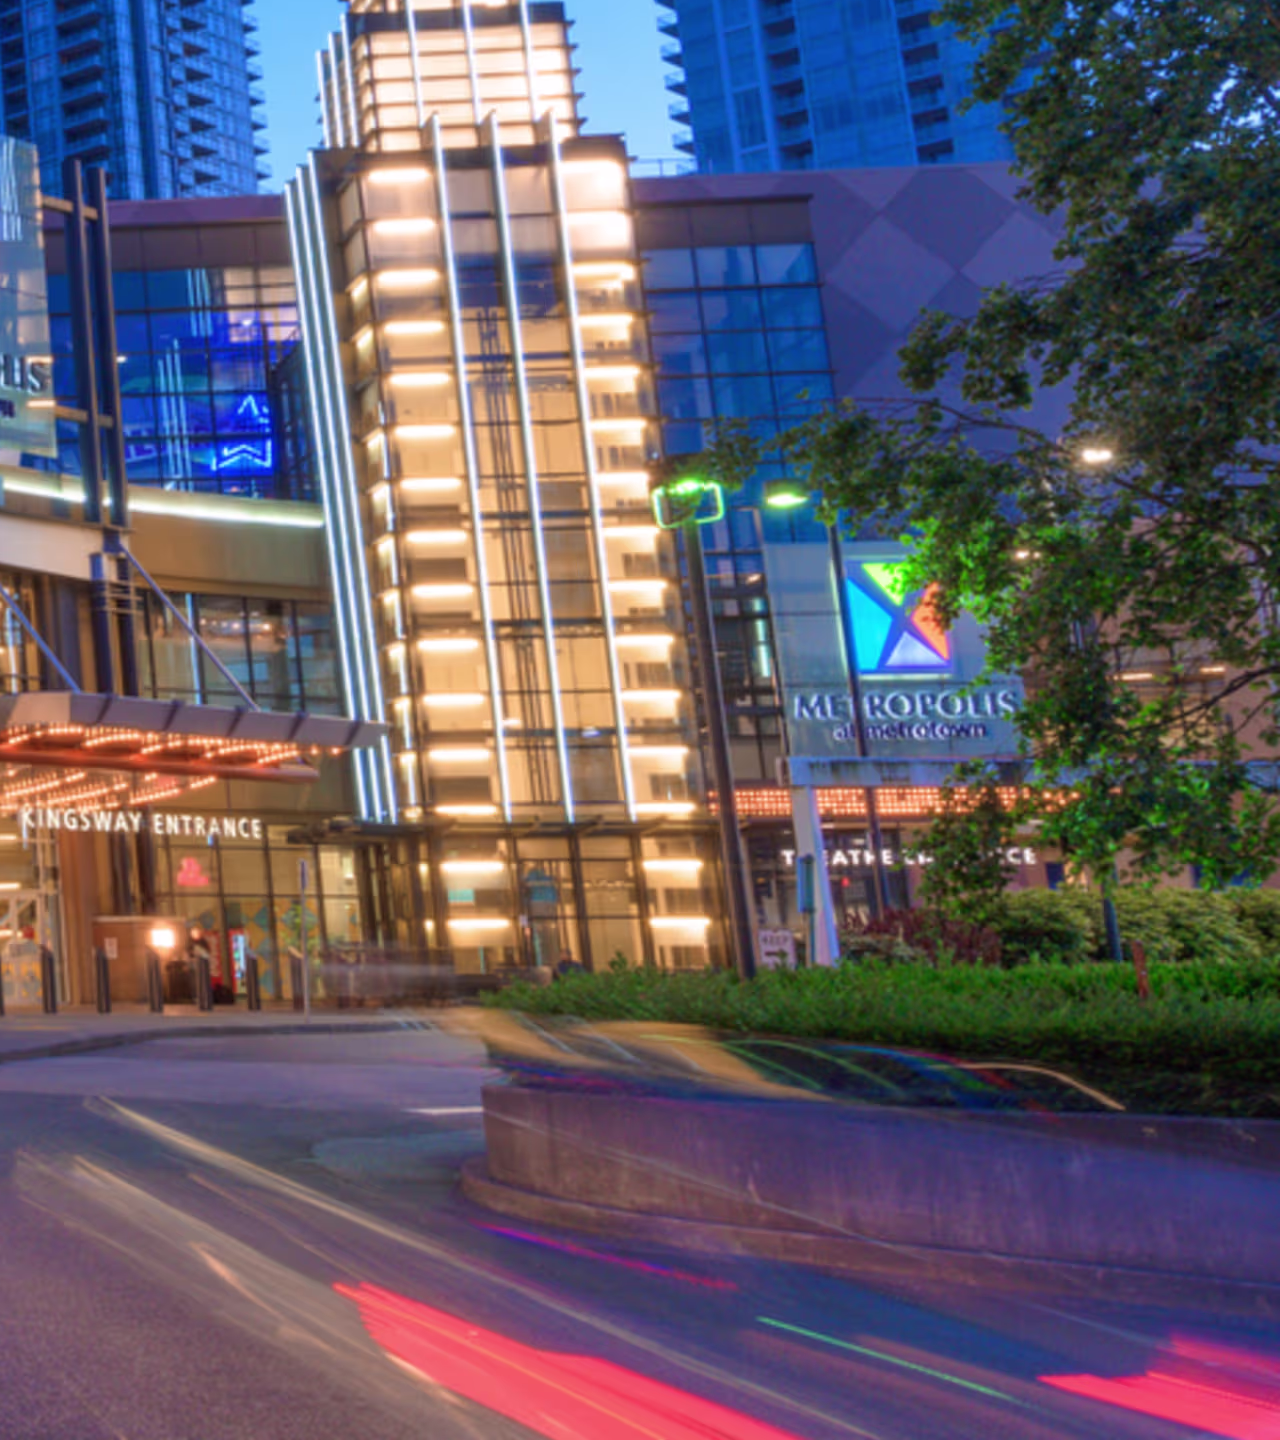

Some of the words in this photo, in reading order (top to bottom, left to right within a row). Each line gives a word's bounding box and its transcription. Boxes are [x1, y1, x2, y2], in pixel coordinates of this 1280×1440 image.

[793, 689, 1020, 721] METROPOLIS
[866, 721, 986, 742] metrotown
[22, 806, 142, 833] KINGSWAY
[153, 813, 263, 840] ENTRANCE
[780, 848, 895, 866] TATRE
